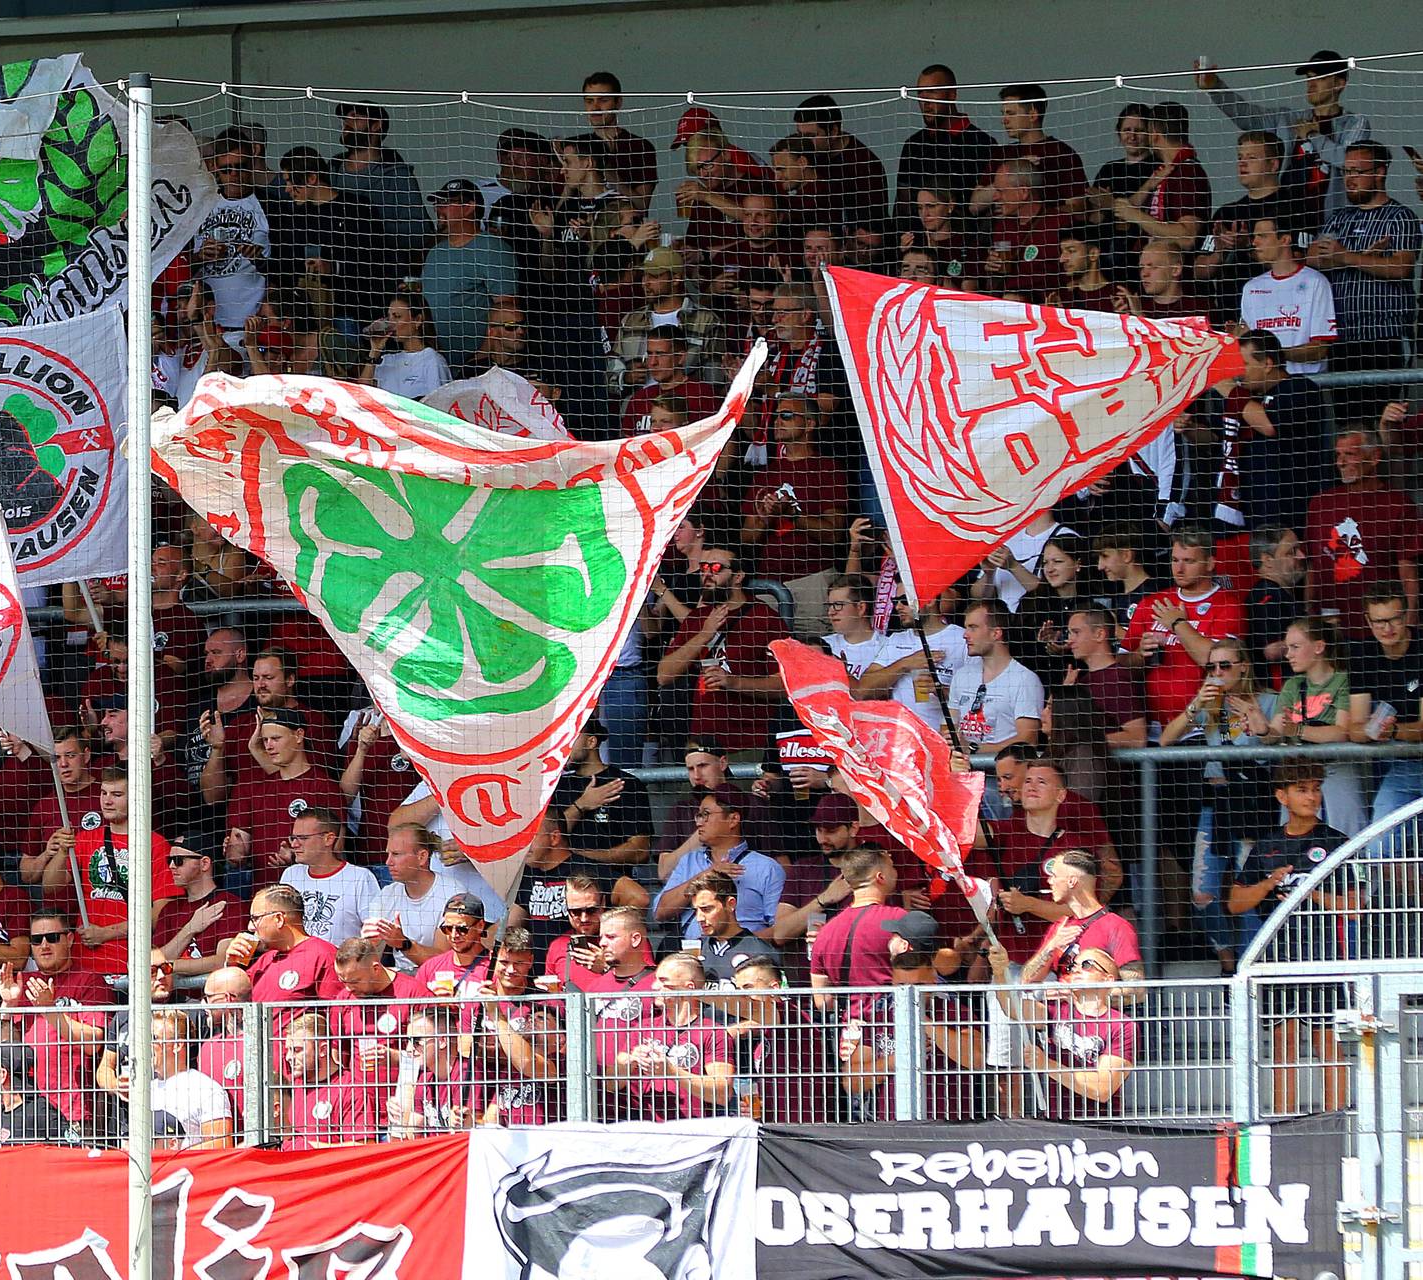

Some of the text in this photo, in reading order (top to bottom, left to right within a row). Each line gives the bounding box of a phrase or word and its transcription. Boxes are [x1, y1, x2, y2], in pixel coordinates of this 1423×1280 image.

[2, 505, 33, 519] 015
[11, 465, 100, 562] AUSEN
[870, 1138, 1160, 1188] Rebellion
[755, 1183, 1310, 1251] OBERHAUSEN
